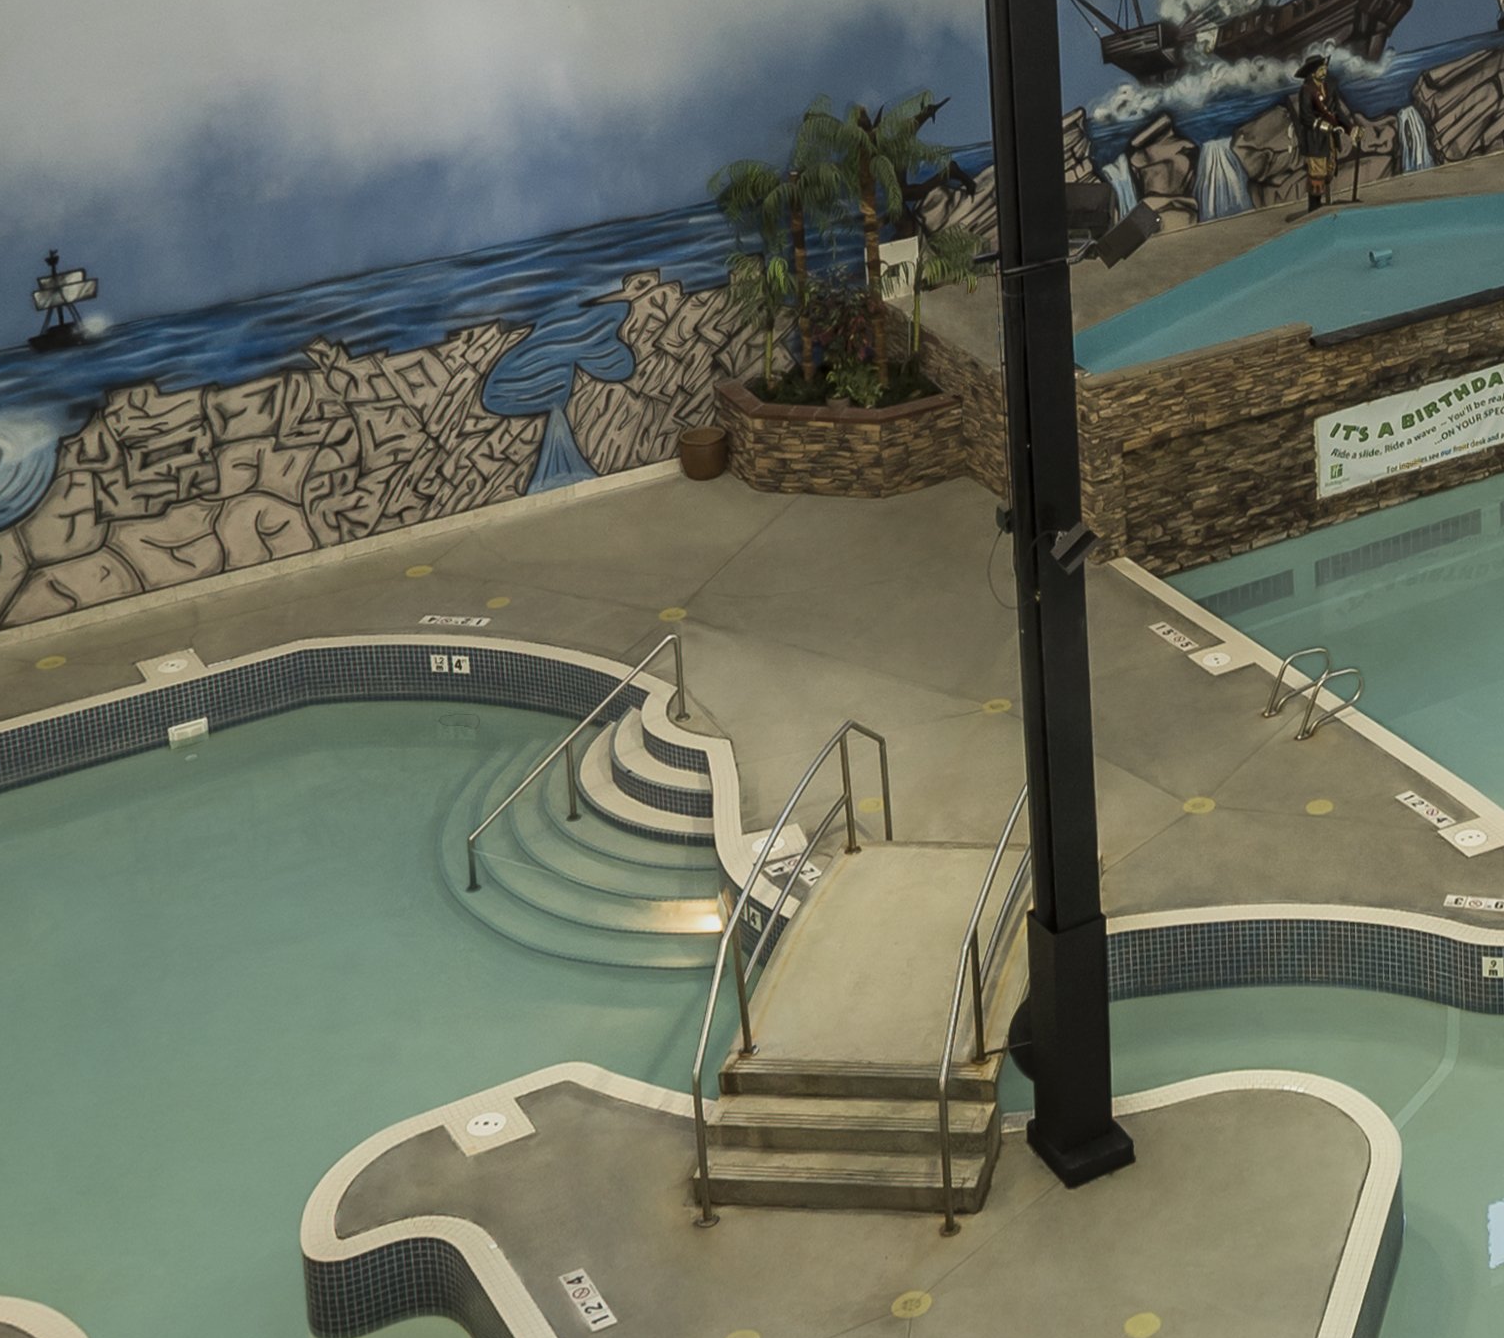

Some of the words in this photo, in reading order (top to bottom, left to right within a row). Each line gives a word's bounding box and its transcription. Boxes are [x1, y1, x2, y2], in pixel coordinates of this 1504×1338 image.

[1330, 423, 1369, 442] IT'S
[1377, 422, 1394, 438] A
[1331, 448, 1351, 459] Ride
[1384, 441, 1405, 453] Ride
[1406, 438, 1413, 446] a
[1413, 426, 1437, 441] wave
[1448, 405, 1472, 423] You'll
[1474, 400, 1486, 410] be
[1488, 392, 1504, 404] real
[1456, 413, 1482, 431] YOUR
[1386, 465, 1398, 473] For
[1428, 453, 1439, 461] see
[1440, 448, 1452, 457] our
[1470, 437, 1485, 447] desk
[1487, 432, 1499, 442] and
